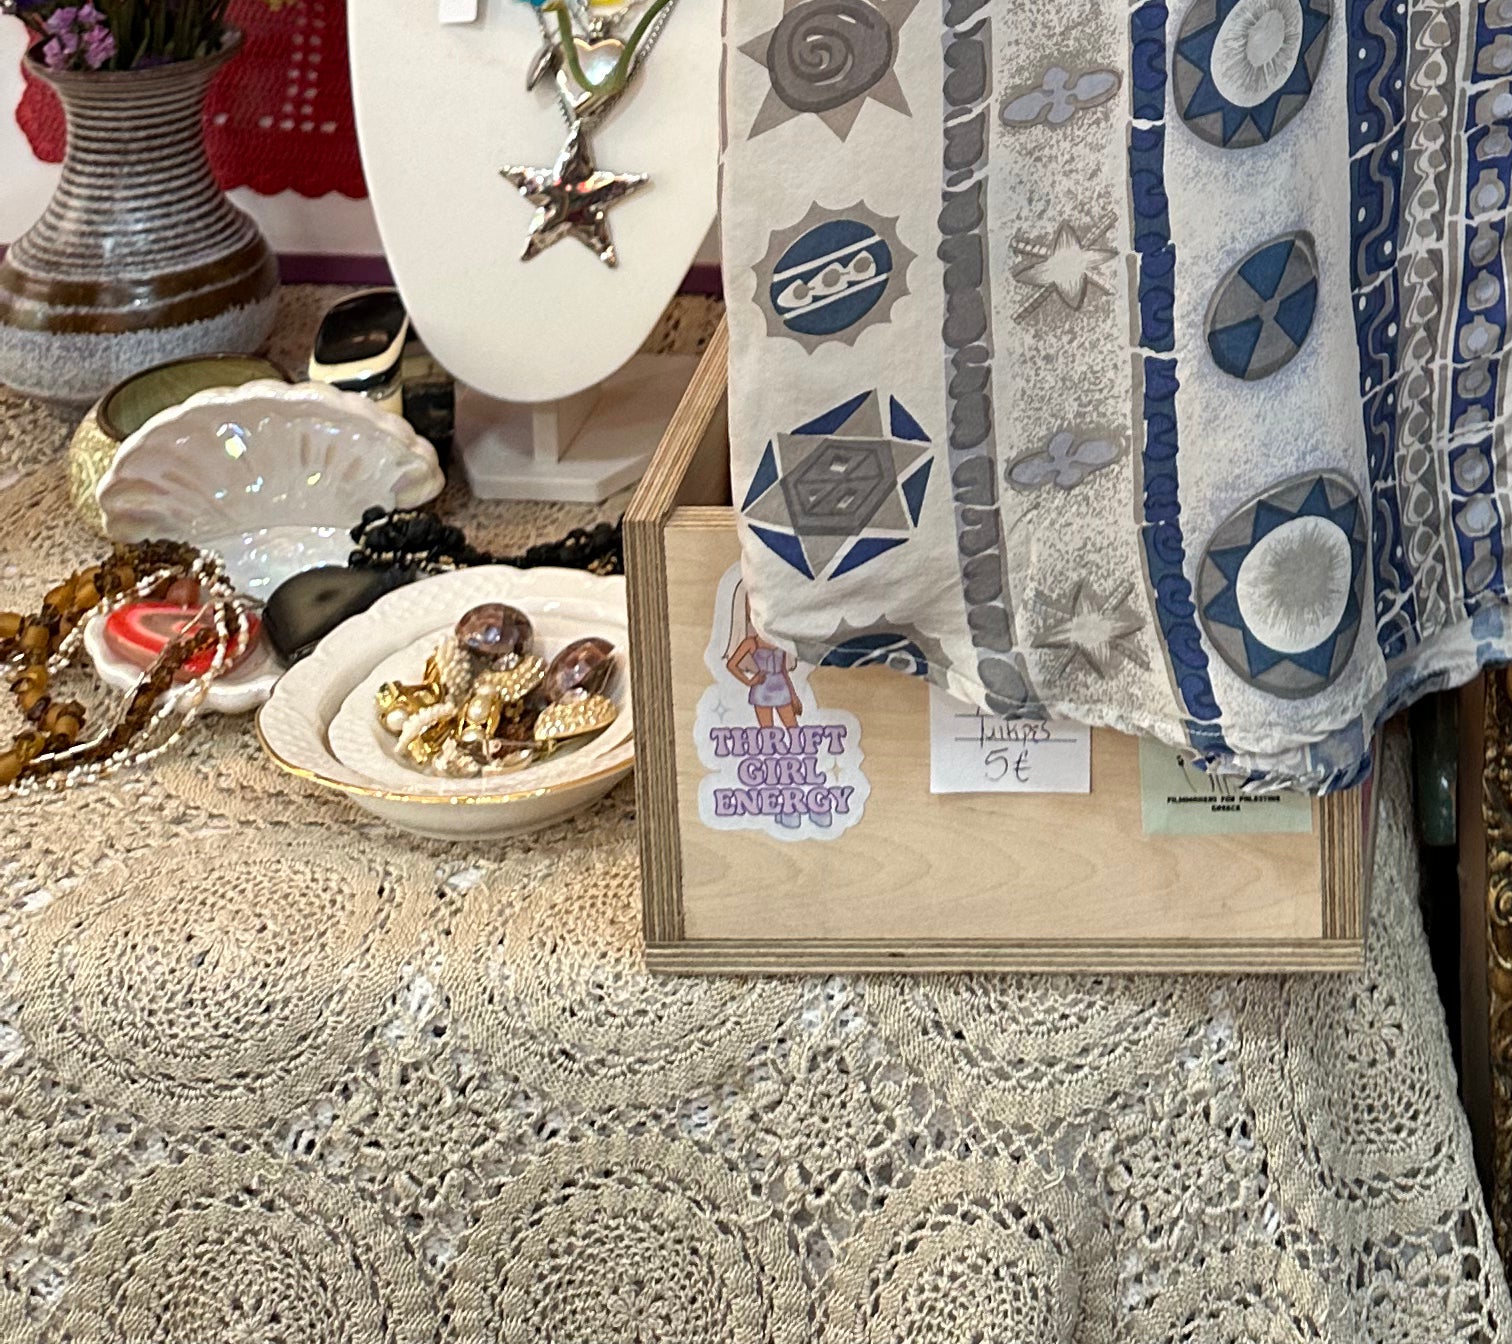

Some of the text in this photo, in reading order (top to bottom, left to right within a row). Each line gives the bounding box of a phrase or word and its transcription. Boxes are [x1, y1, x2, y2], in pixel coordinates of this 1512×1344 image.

[709, 724, 848, 758] THRIFT
[737, 755, 827, 787] GIRL
[984, 747, 1033, 783] 5€
[713, 785, 856, 817] ENERGY
